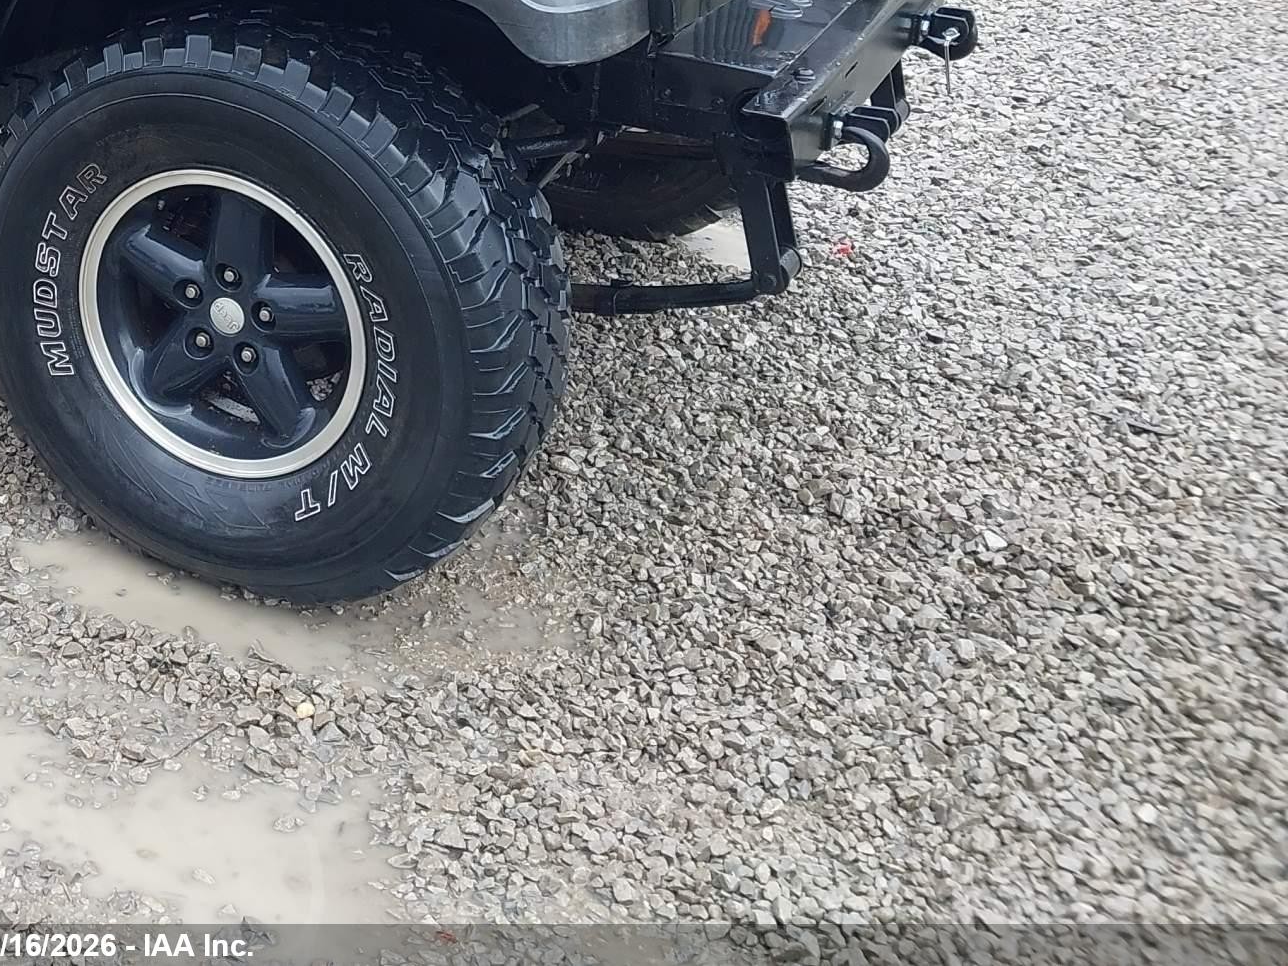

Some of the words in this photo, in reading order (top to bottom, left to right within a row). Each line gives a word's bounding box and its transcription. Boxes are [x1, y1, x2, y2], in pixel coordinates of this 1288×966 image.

[33, 163, 108, 376] MUDSTAR
[343, 253, 402, 437] RADIAL
[294, 442, 372, 521] M/T
